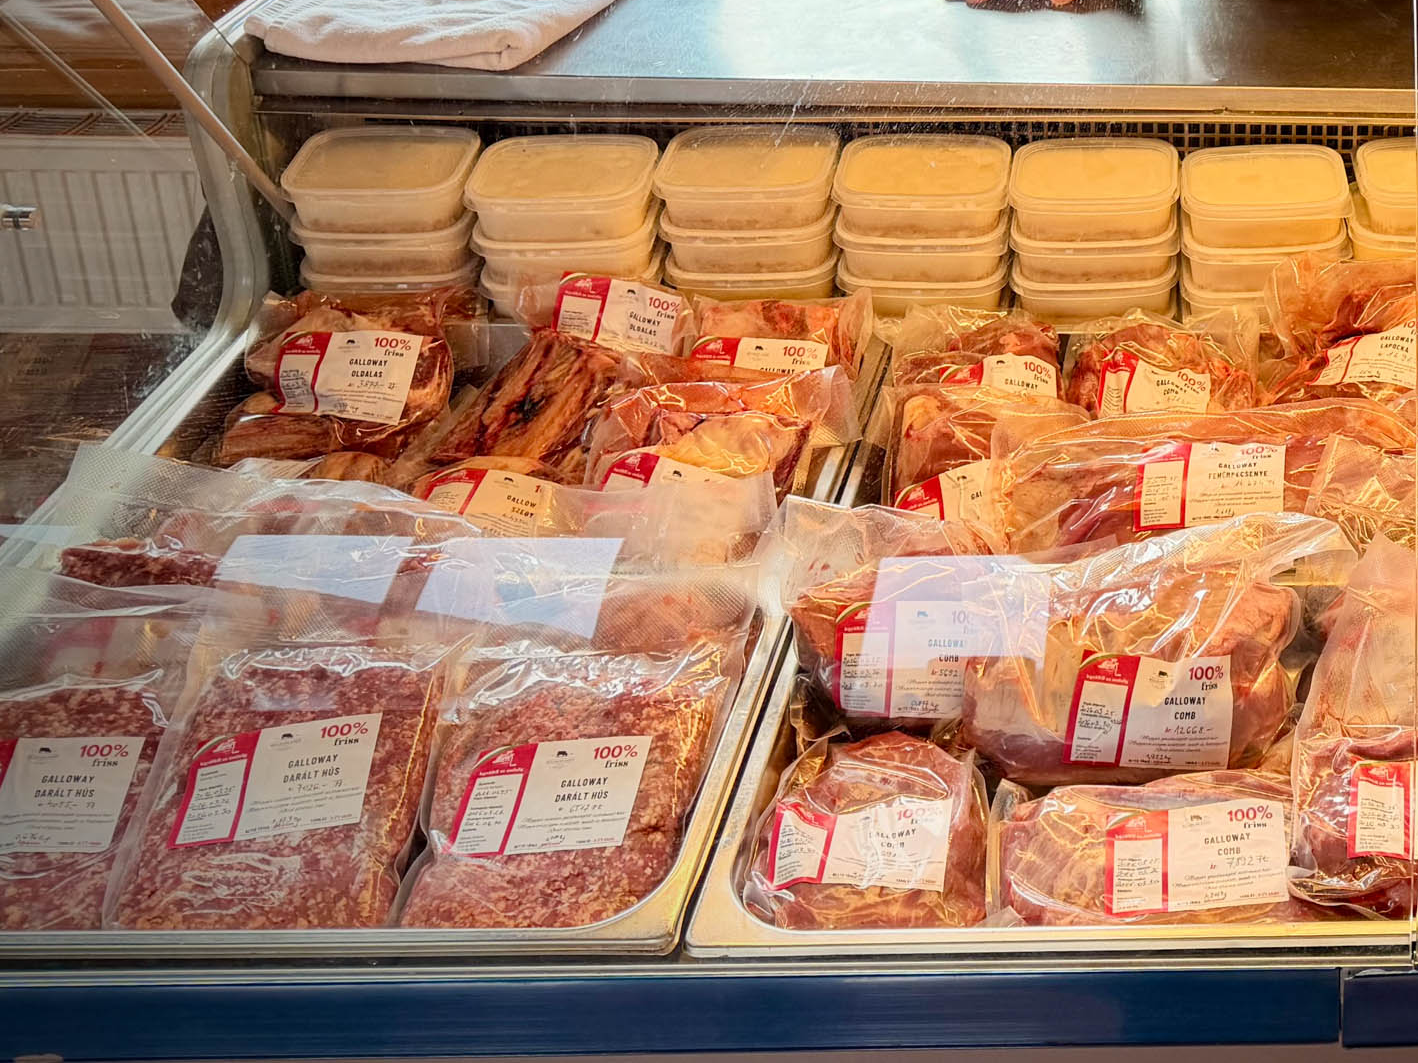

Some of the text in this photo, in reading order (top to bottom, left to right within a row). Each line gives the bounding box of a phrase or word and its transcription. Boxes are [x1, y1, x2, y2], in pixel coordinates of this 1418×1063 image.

[649, 297, 680, 314] 100%
[629, 311, 660, 327] GALLOWAY
[374, 337, 412, 351] 100%
[1380, 336, 1414, 344] GALLOWAY
[783, 346, 818, 359] 100%
[349, 359, 387, 367] GALLOWAY
[351, 370, 383, 378] OLDALAS
[1024, 361, 1051, 379] 100%
[1004, 378, 1038, 390] GALLOWAY
[1178, 371, 1206, 392] 100%
[939, 654, 959, 662] COMB
[1189, 665, 1224, 681] 100%
[1164, 696, 1206, 706] GALLOWAY
[1174, 712, 1196, 720] COMB
[320, 721, 369, 738] 100%
[80, 744, 129, 757] 100%
[593, 744, 638, 760] 100%
[288, 754, 339, 768] GALLOWAY
[41, 775, 95, 783] GALLOWAY
[283, 766, 340, 783] DARÁLT HÚS
[560, 777, 608, 788] GALLOWAY
[34, 788, 95, 797] DARÁLT HÚS
[554, 789, 609, 803] DARÁLT HÚS
[1227, 804, 1273, 822] 100%
[1204, 833, 1251, 845] GALLOWAY
[1217, 848, 1241, 856] COMB
